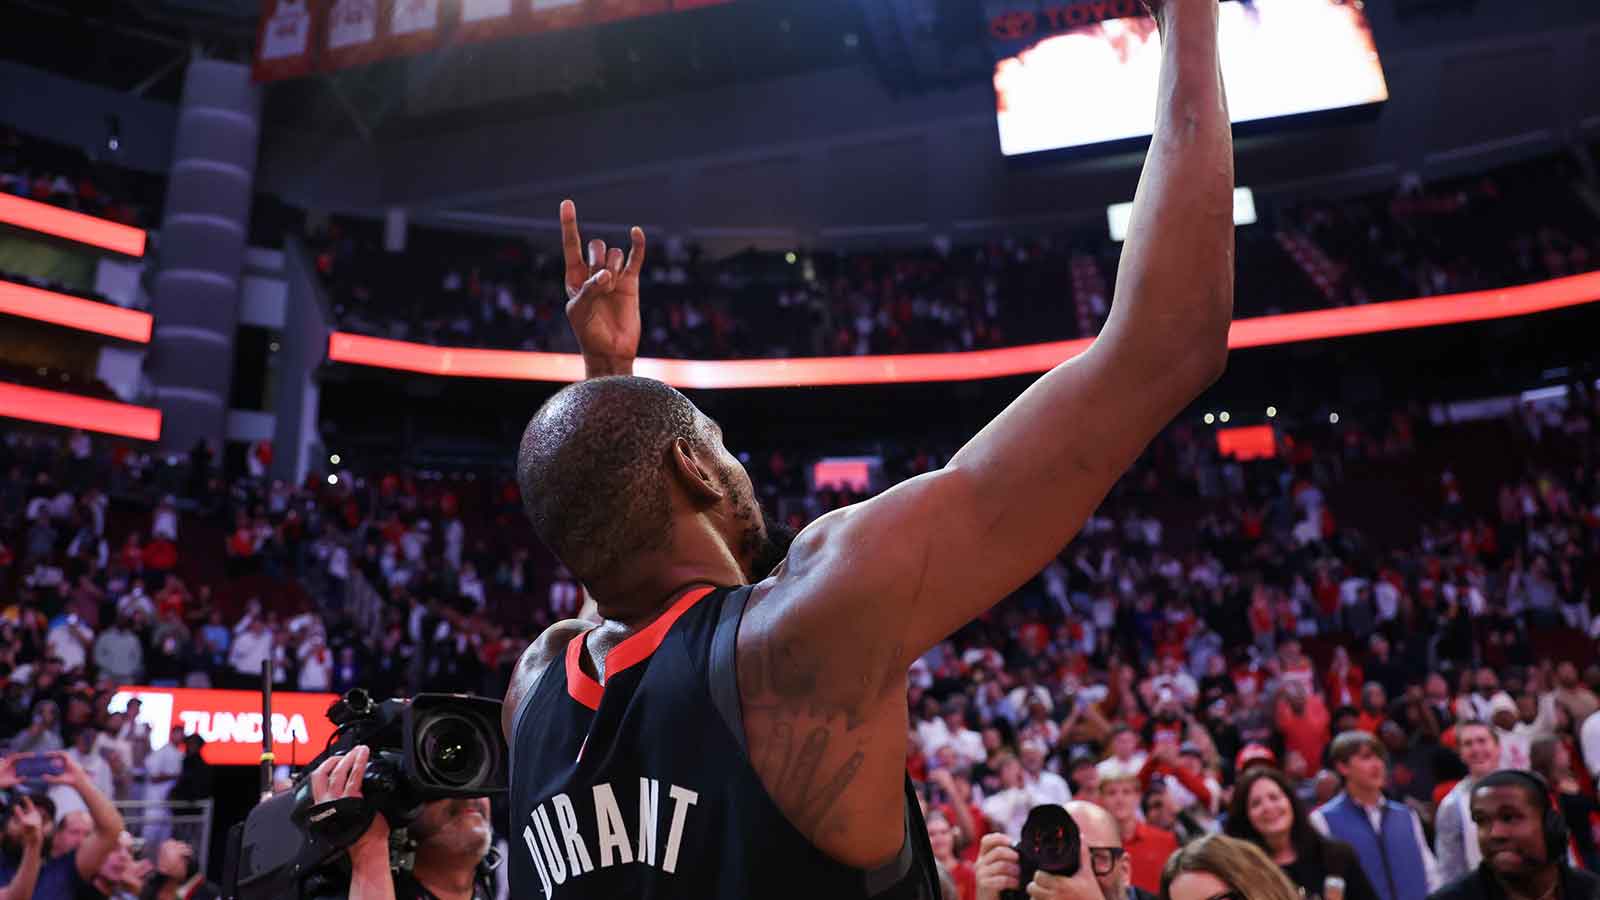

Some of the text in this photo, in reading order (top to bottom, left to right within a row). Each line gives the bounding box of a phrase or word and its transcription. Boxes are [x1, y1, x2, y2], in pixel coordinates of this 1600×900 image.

[1046, 0, 1136, 28] TOYO
[180, 710, 309, 744] TUNDRA
[522, 776, 698, 900] DURANT
